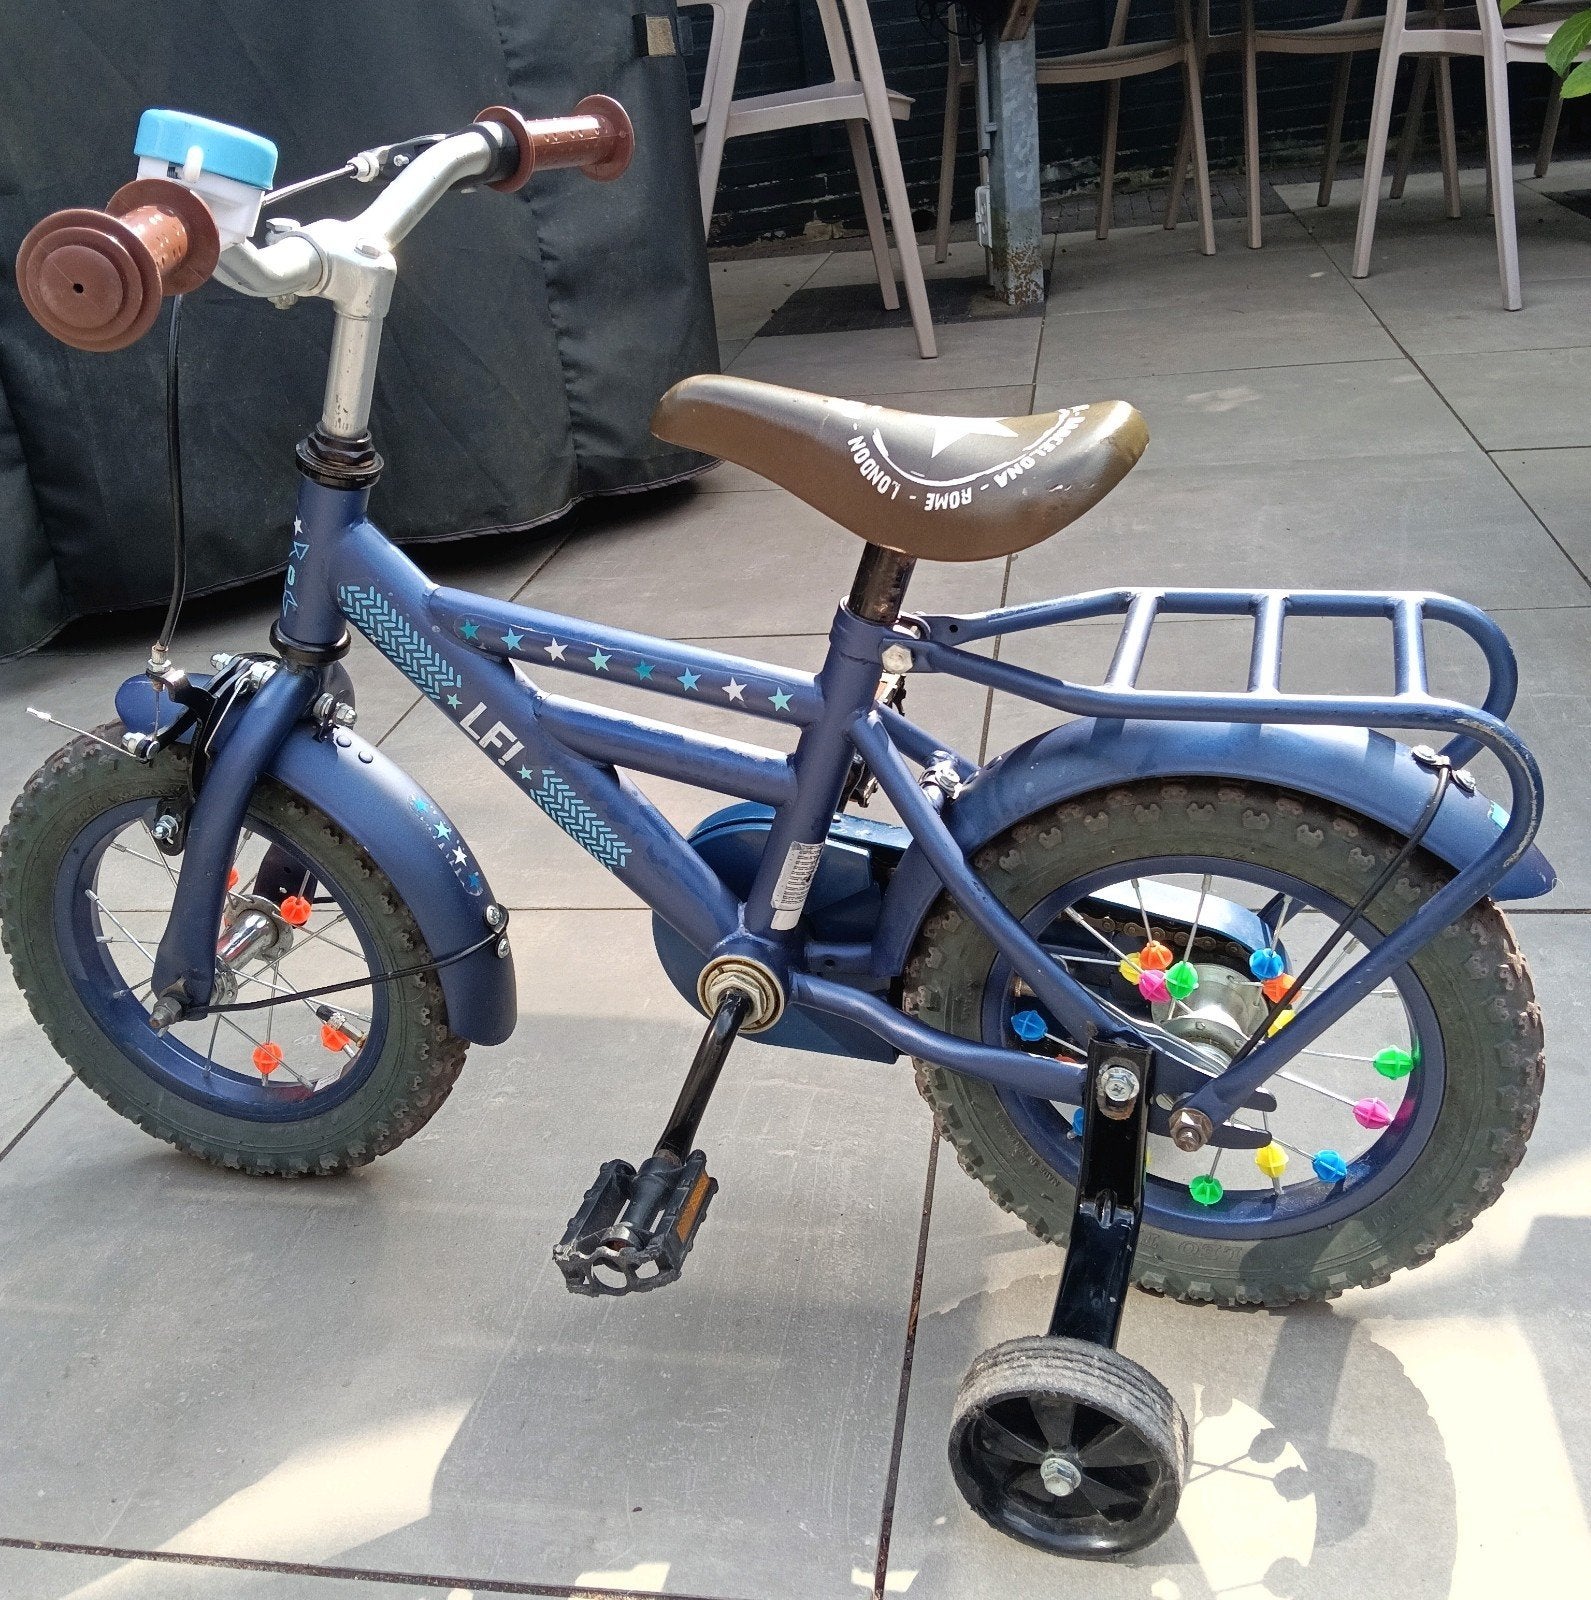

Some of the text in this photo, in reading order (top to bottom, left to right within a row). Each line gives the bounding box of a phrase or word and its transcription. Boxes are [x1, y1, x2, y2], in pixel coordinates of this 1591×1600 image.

[847, 435, 901, 500] LONDON
[924, 487, 972, 511] ROME
[459, 701, 525, 767] LF!
